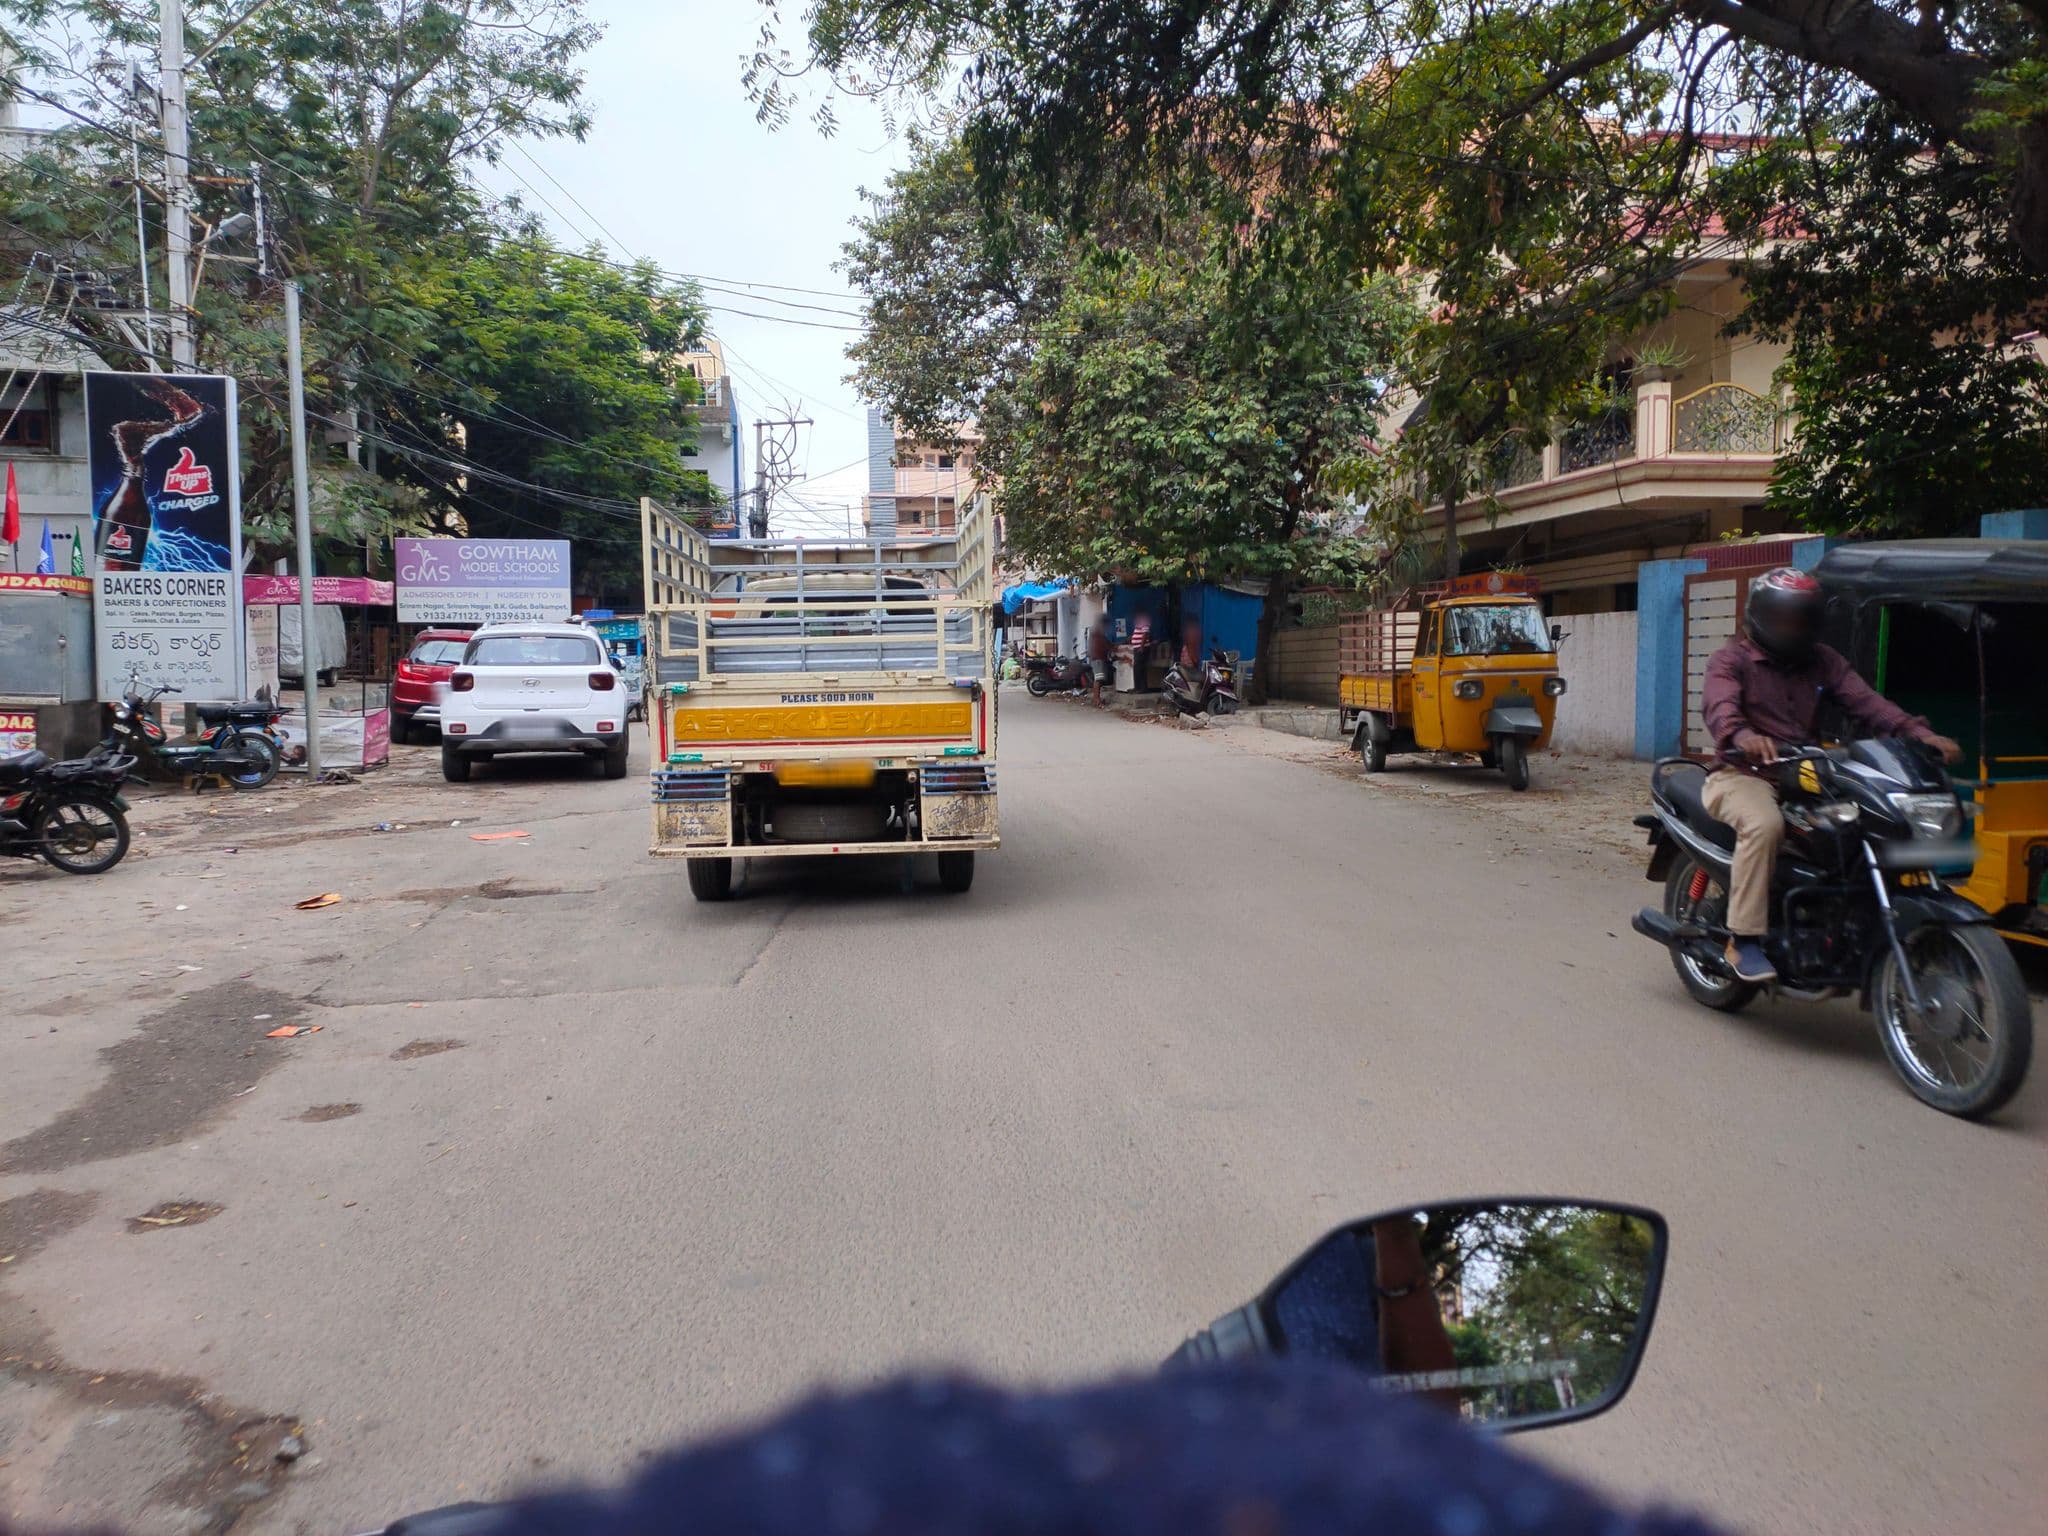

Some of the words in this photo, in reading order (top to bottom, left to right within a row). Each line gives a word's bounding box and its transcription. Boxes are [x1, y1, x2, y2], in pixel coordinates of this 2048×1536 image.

[159, 495, 219, 511] CHARGED
[458, 546, 557, 560] GOWTHAM
[401, 565, 450, 582] GMS
[460, 562, 500, 572] MODEL
[504, 563, 560, 573] SCHOOLS
[104, 578, 162, 595] BAKERS
[166, 579, 226, 596] CORNER
[104, 599, 141, 607] BAKERS
[152, 600, 226, 608] CONFECTIONERS
[112, 631, 160, 656] బేకర్స్
[170, 634, 222, 657] కార్నర్
[781, 694, 818, 703] PLEASE
[820, 693, 846, 702] SOUD
[848, 692, 874, 702] HORN
[679, 711, 801, 734] ASHOK
[808, 707, 968, 731] LEYLAND
